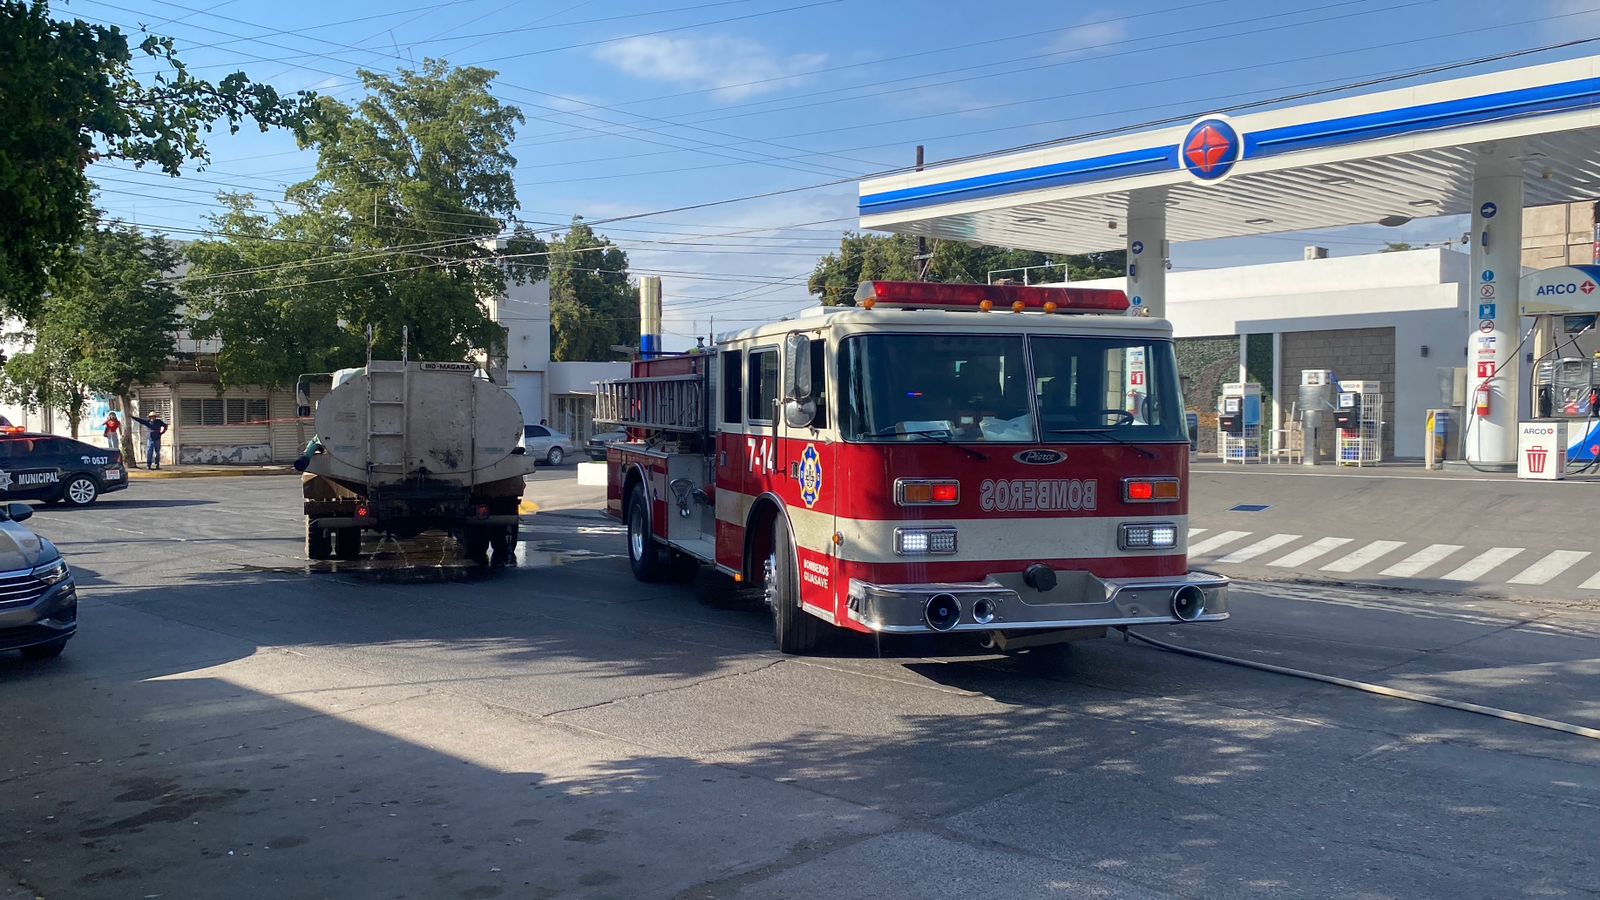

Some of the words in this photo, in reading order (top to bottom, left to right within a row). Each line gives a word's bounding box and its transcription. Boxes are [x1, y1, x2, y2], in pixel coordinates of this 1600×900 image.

[1536, 283, 1577, 296] ARCO
[92, 456, 108, 465] 0637
[1026, 451, 1055, 461] Pierce
[18, 471, 60, 485] MUNICIPAL
[803, 558, 829, 577] BOMBEROS
[803, 571, 829, 590] GUASAVE
